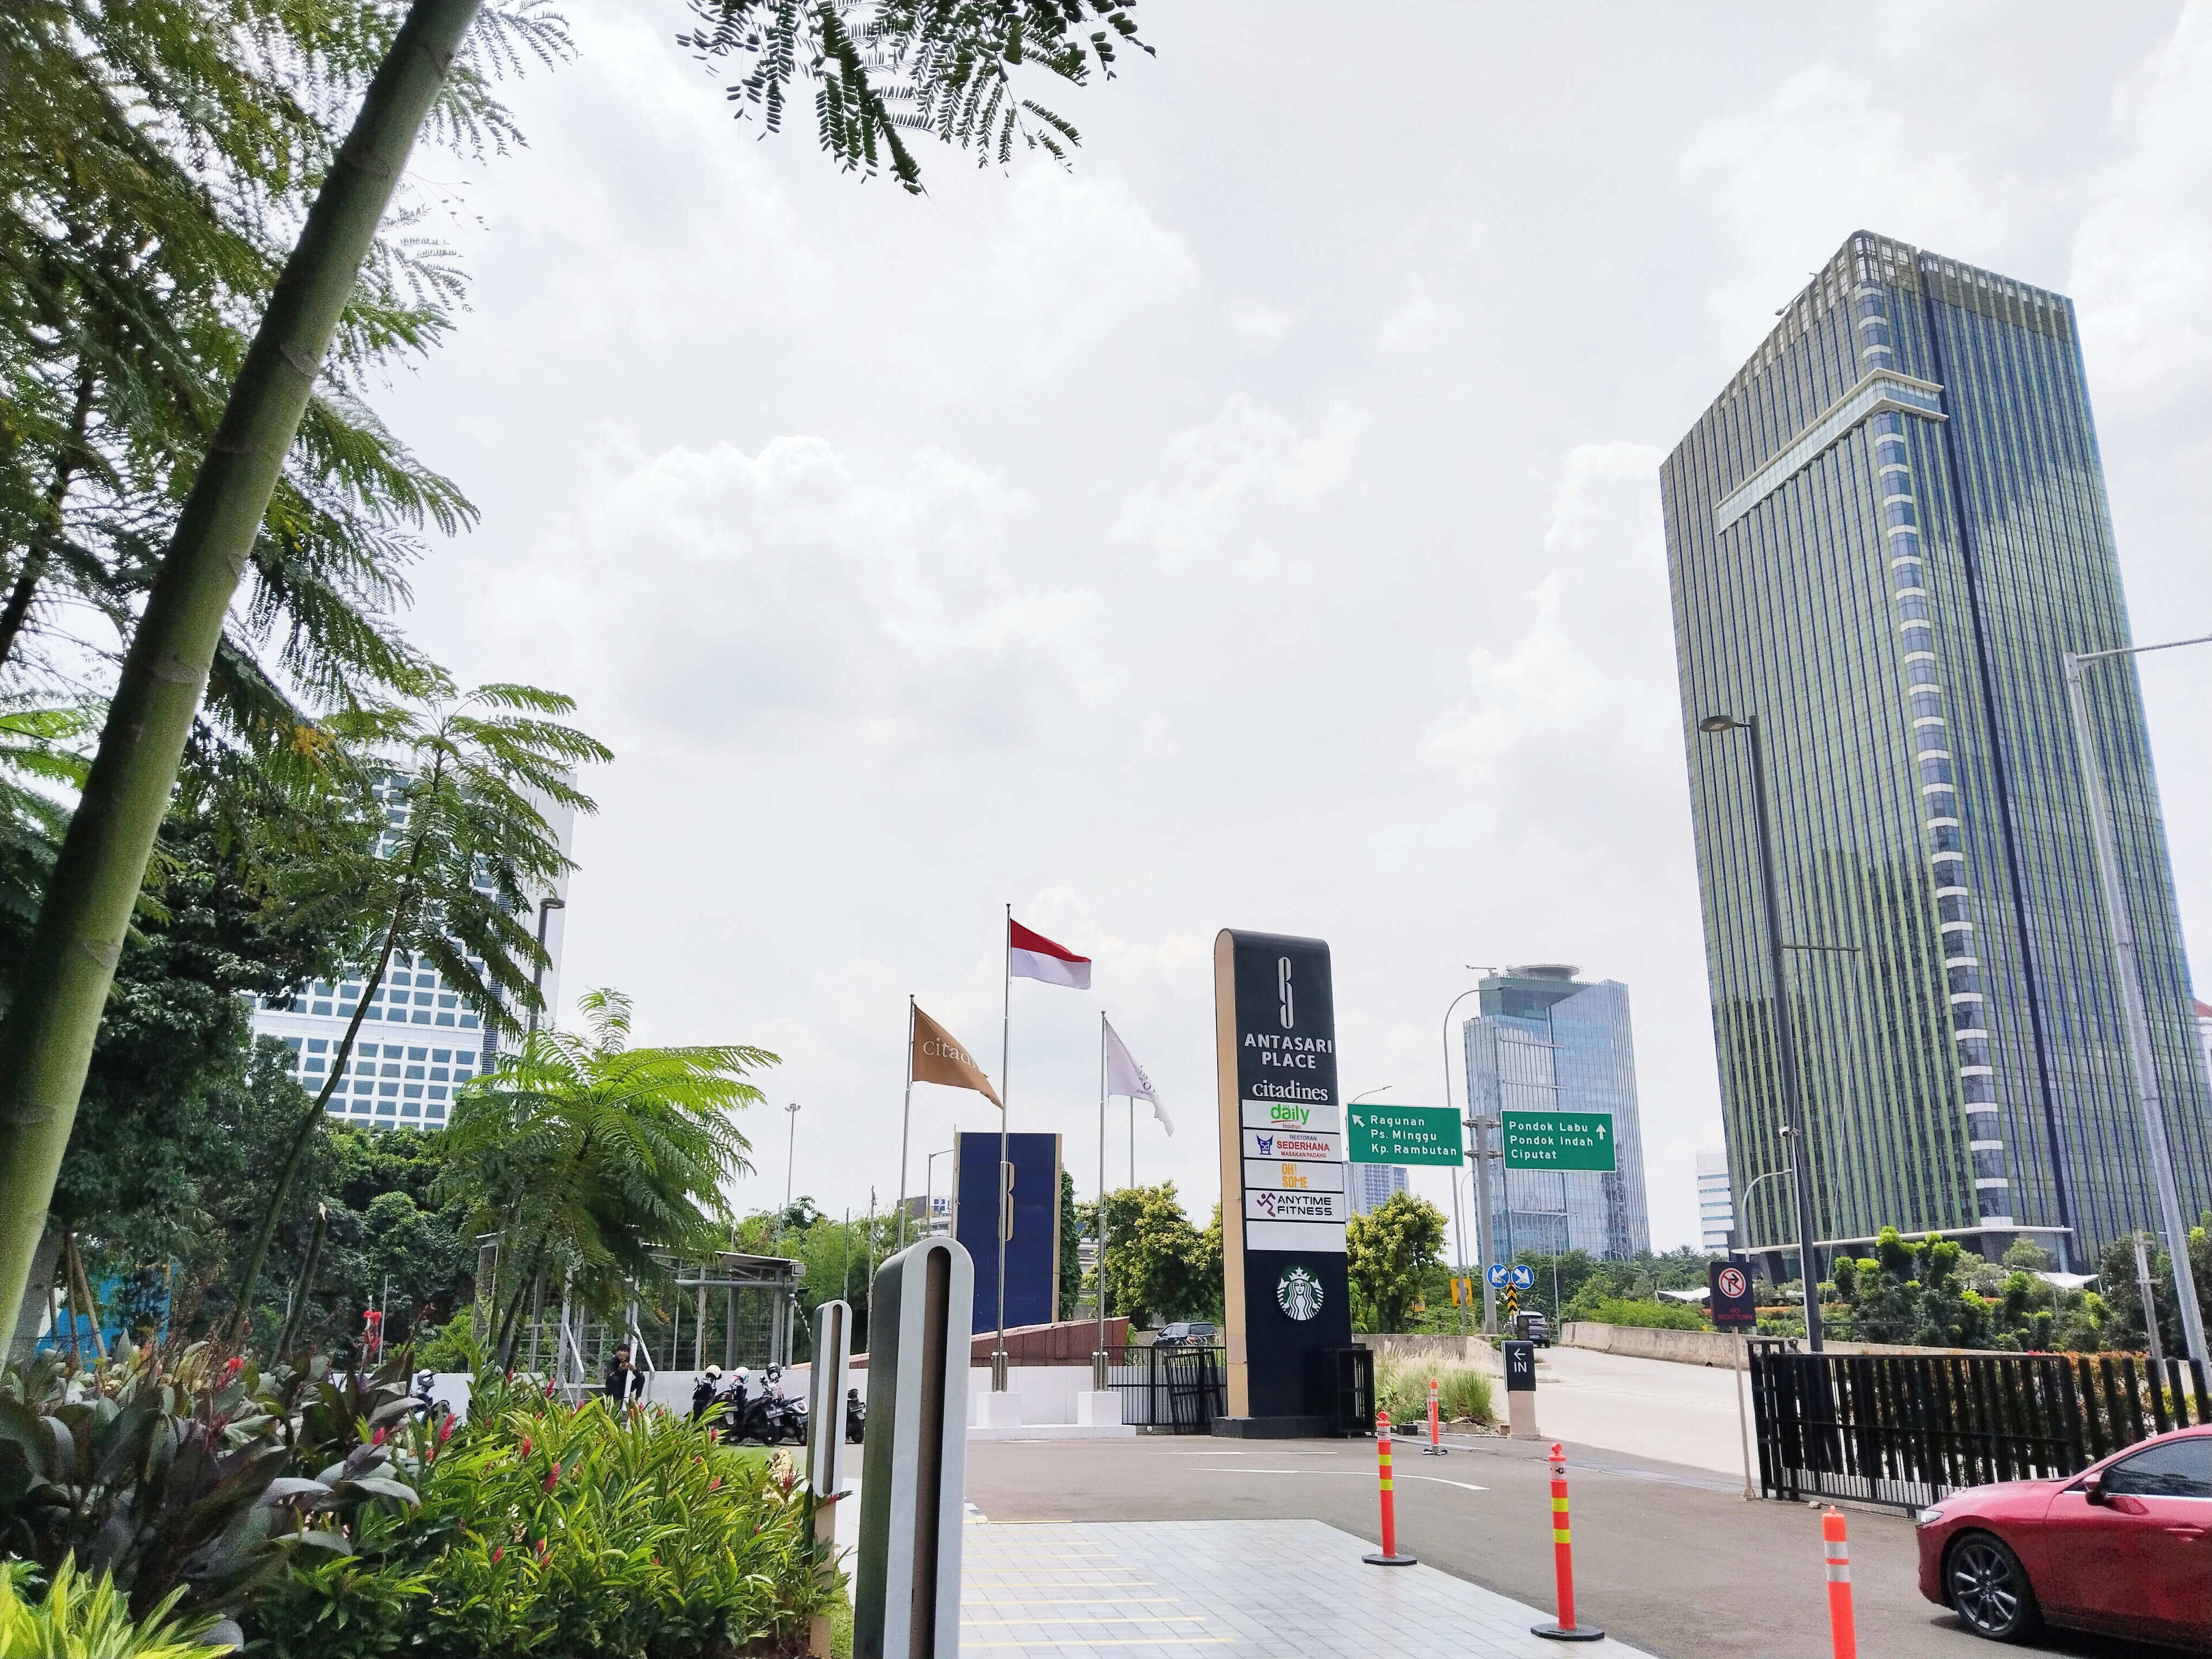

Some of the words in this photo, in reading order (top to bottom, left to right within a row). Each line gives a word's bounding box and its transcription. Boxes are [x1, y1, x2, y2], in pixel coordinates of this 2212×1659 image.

[1244, 1033, 1332, 1053] ANTASARI
[1262, 1051, 1316, 1069] PLACE
[1252, 1080, 1328, 1101] citadines
[1271, 1104, 1310, 1125] daily
[1370, 1115, 1425, 1127] Ragunan
[1509, 1121, 1554, 1131] Pondok
[1559, 1123, 1588, 1132] Labu
[1371, 1129, 1388, 1138] Ps.
[1392, 1130, 1437, 1143] Minggu
[1510, 1135, 1554, 1145] Pondok
[1560, 1137, 1593, 1146] Indah
[1277, 1141, 1330, 1152] SEDERHANA
[1372, 1143, 1389, 1155] Kp.
[1394, 1144, 1457, 1156] Rambutan
[1511, 1149, 1557, 1161] Ciputat
[1282, 1163, 1297, 1175] OH!
[1282, 1176, 1308, 1188] SOME
[1278, 1195, 1332, 1205] ANYTIME
[1278, 1206, 1332, 1215] FITNESS
[1514, 1361, 1527, 1373] IN
